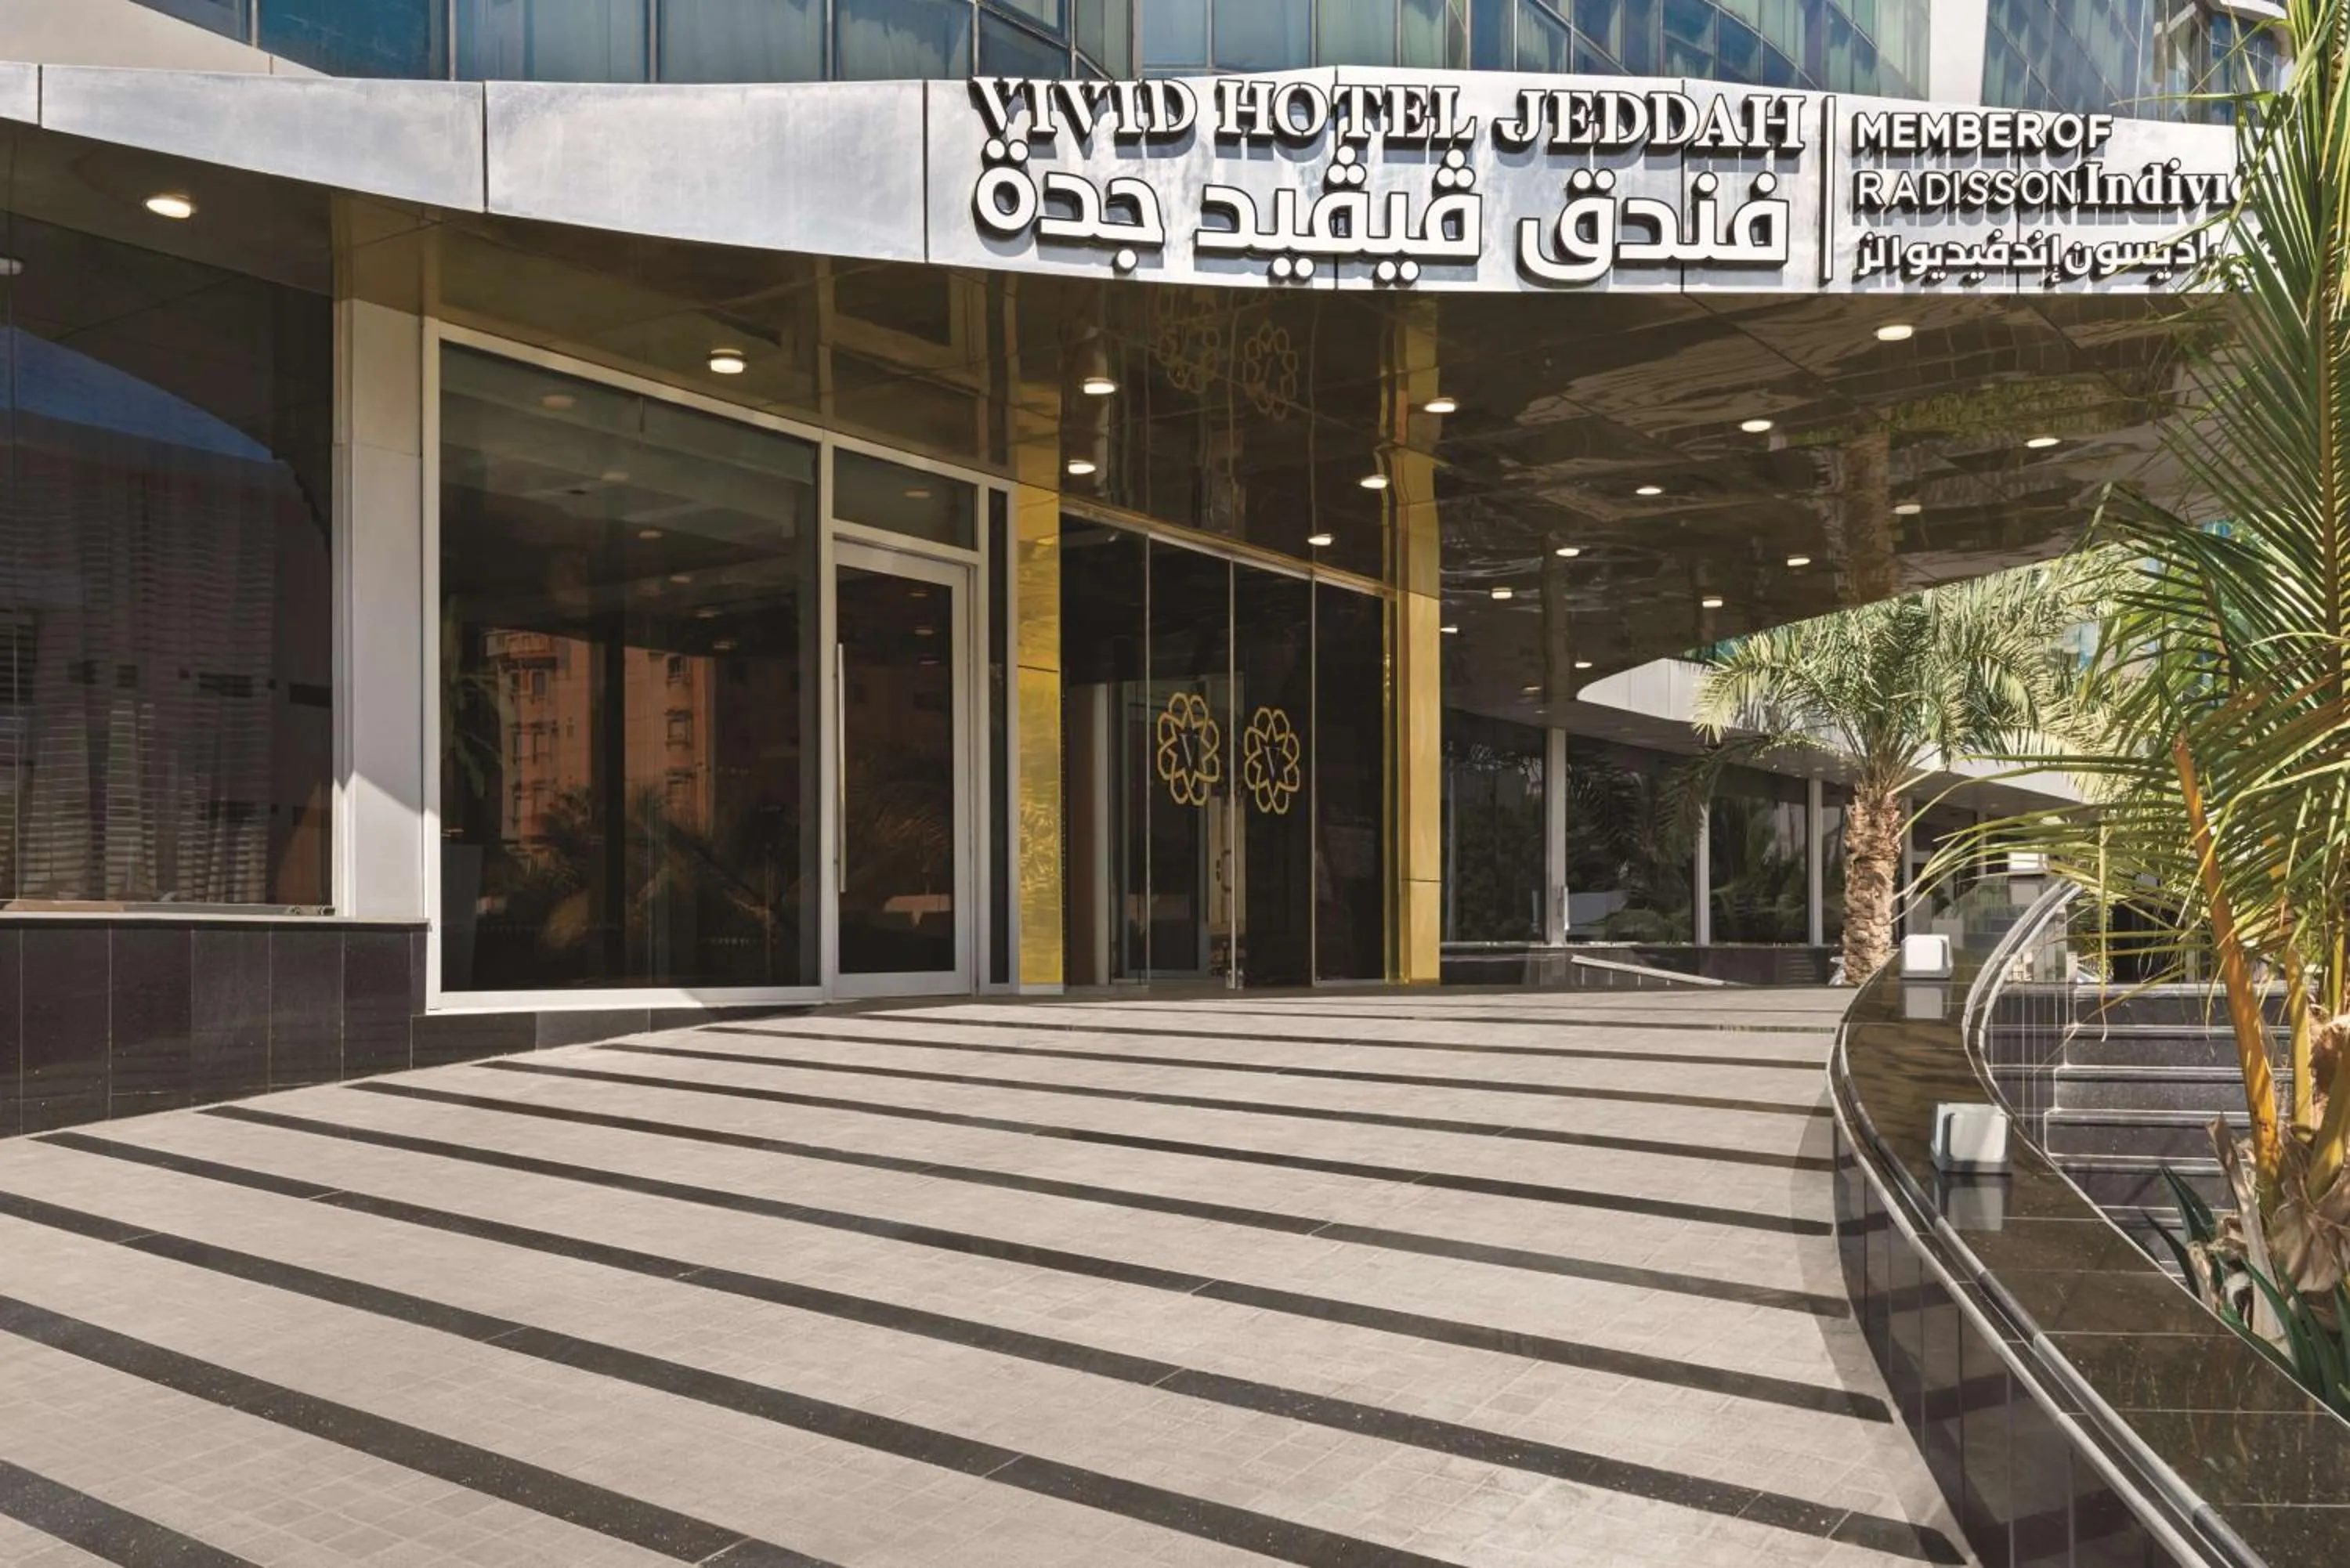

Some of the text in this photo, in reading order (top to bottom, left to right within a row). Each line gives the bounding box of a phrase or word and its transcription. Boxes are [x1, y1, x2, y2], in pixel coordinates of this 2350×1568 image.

[970, 76, 1806, 150] VIVID HOTEL JEDDAH
[1854, 111, 2113, 150] MEMBER OF
[974, 137, 1165, 270] جدة
[1856, 169, 2081, 207] RADISSON
[1519, 170, 1790, 283] فندق
